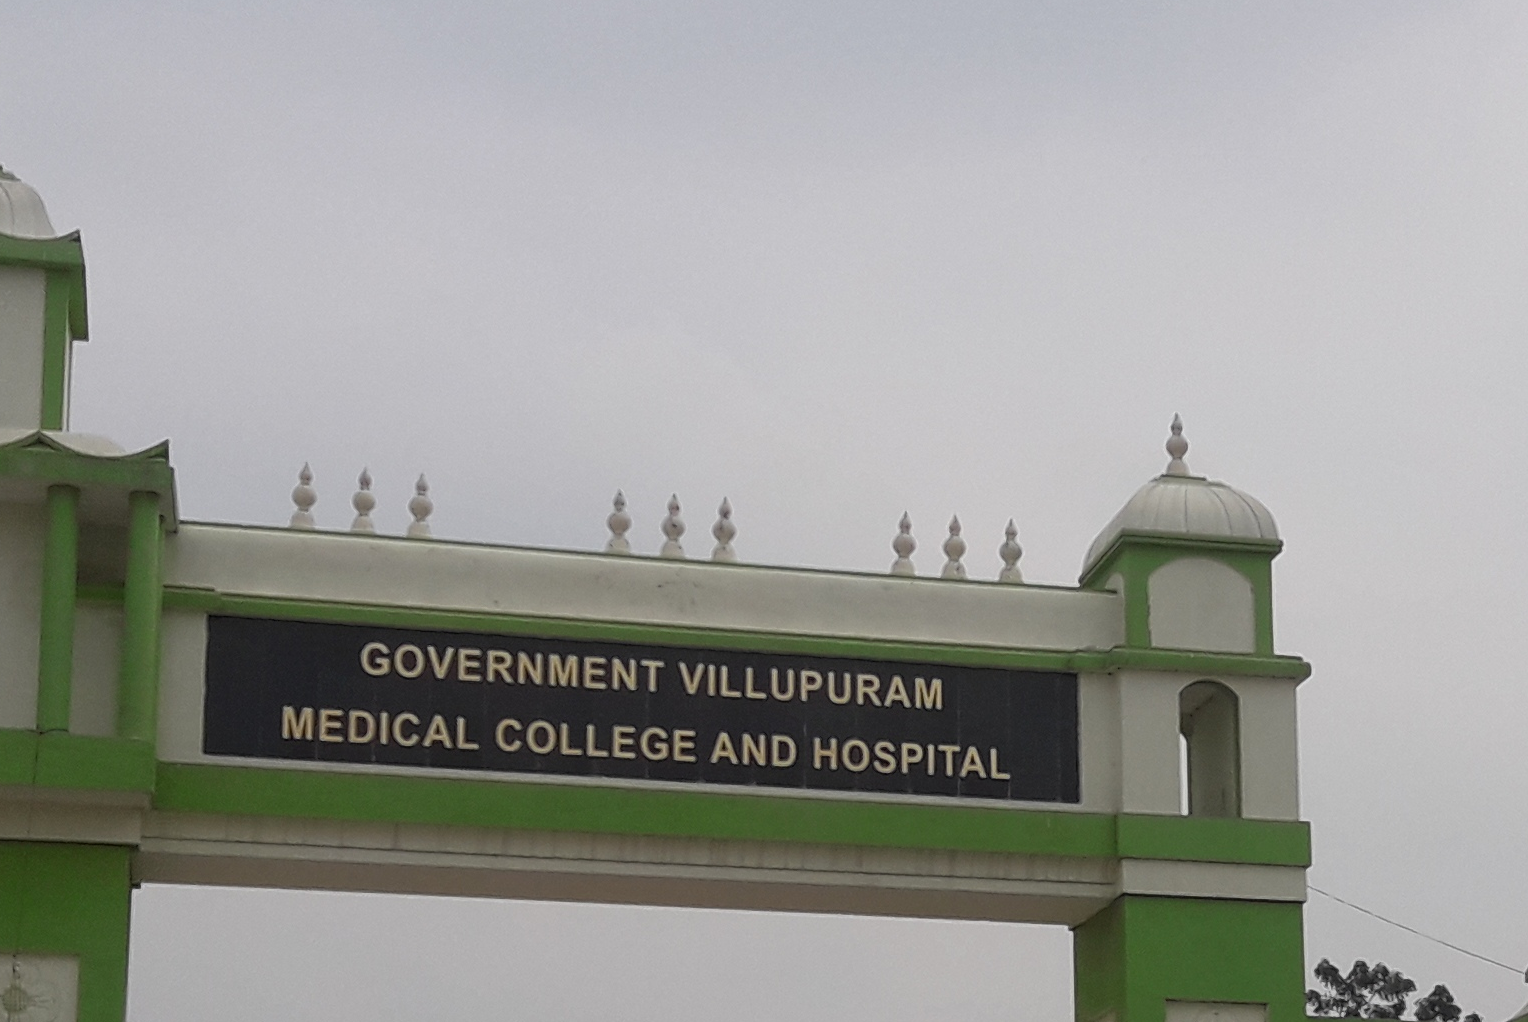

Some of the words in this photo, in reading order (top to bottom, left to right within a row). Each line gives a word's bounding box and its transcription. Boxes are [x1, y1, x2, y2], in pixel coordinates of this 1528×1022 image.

[360, 642, 665, 692] GOVERNMENT
[678, 661, 943, 710] VILLUPURAM
[280, 705, 480, 750] MEDICAL
[495, 718, 697, 762] COLLEGE
[710, 731, 797, 767] AND
[813, 737, 1011, 780] HOSPITAL
